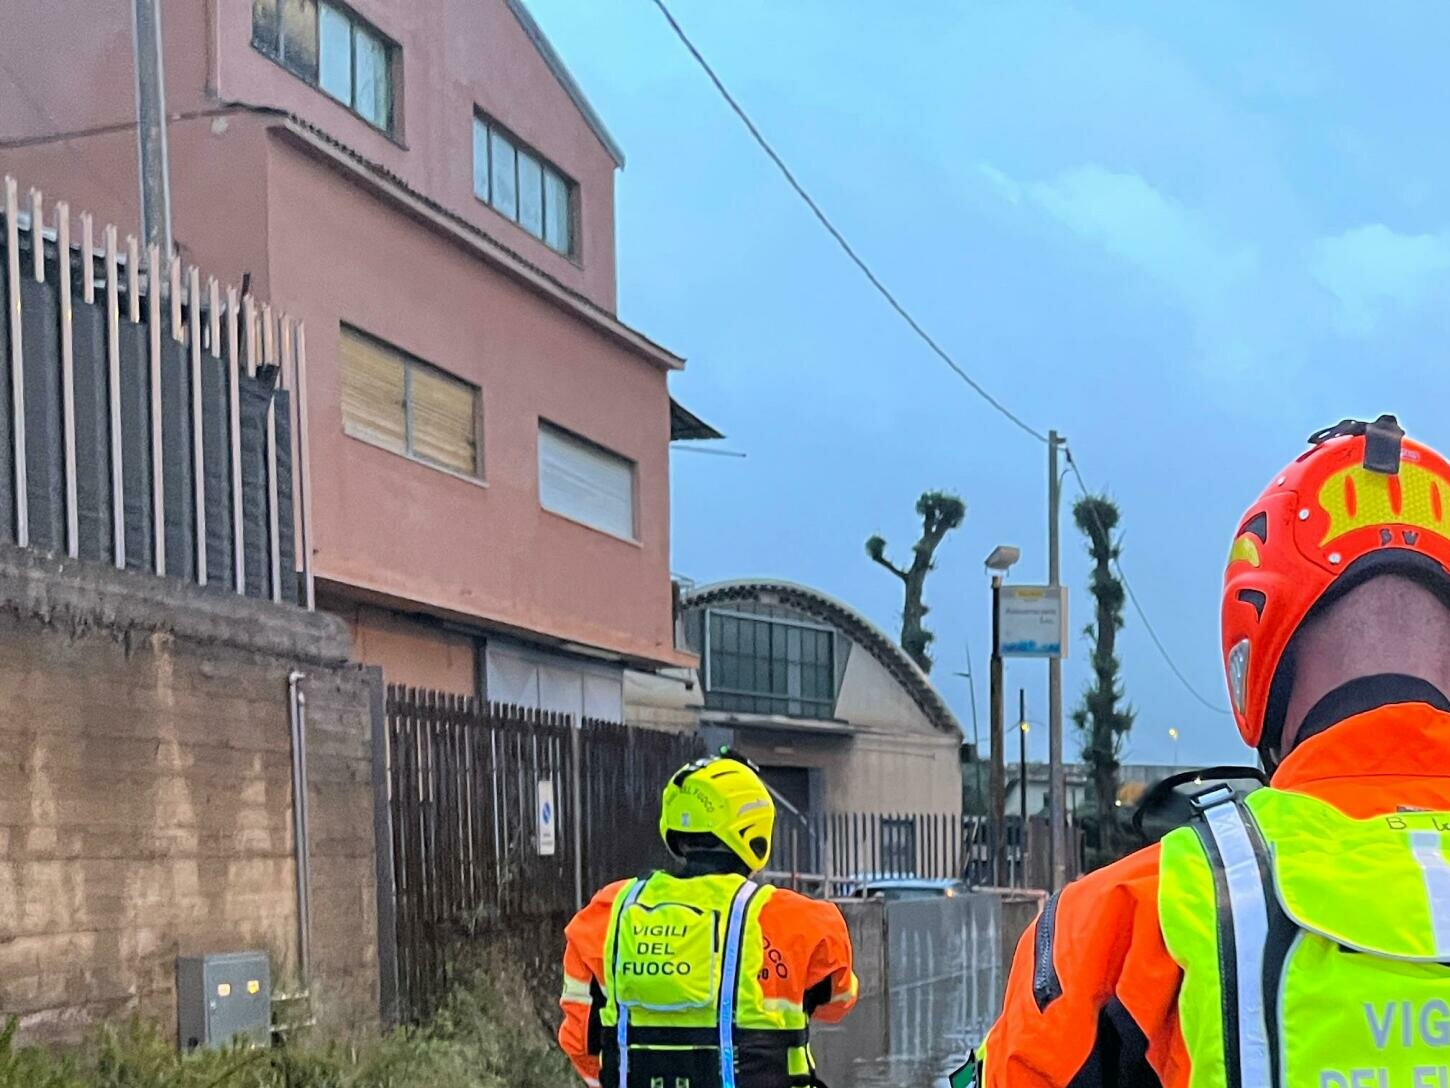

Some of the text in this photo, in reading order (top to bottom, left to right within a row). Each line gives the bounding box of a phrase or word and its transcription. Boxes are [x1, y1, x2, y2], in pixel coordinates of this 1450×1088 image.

[633, 924, 688, 938] VIGILI
[637, 942, 675, 955] DEL
[622, 961, 691, 976] FUOCO
